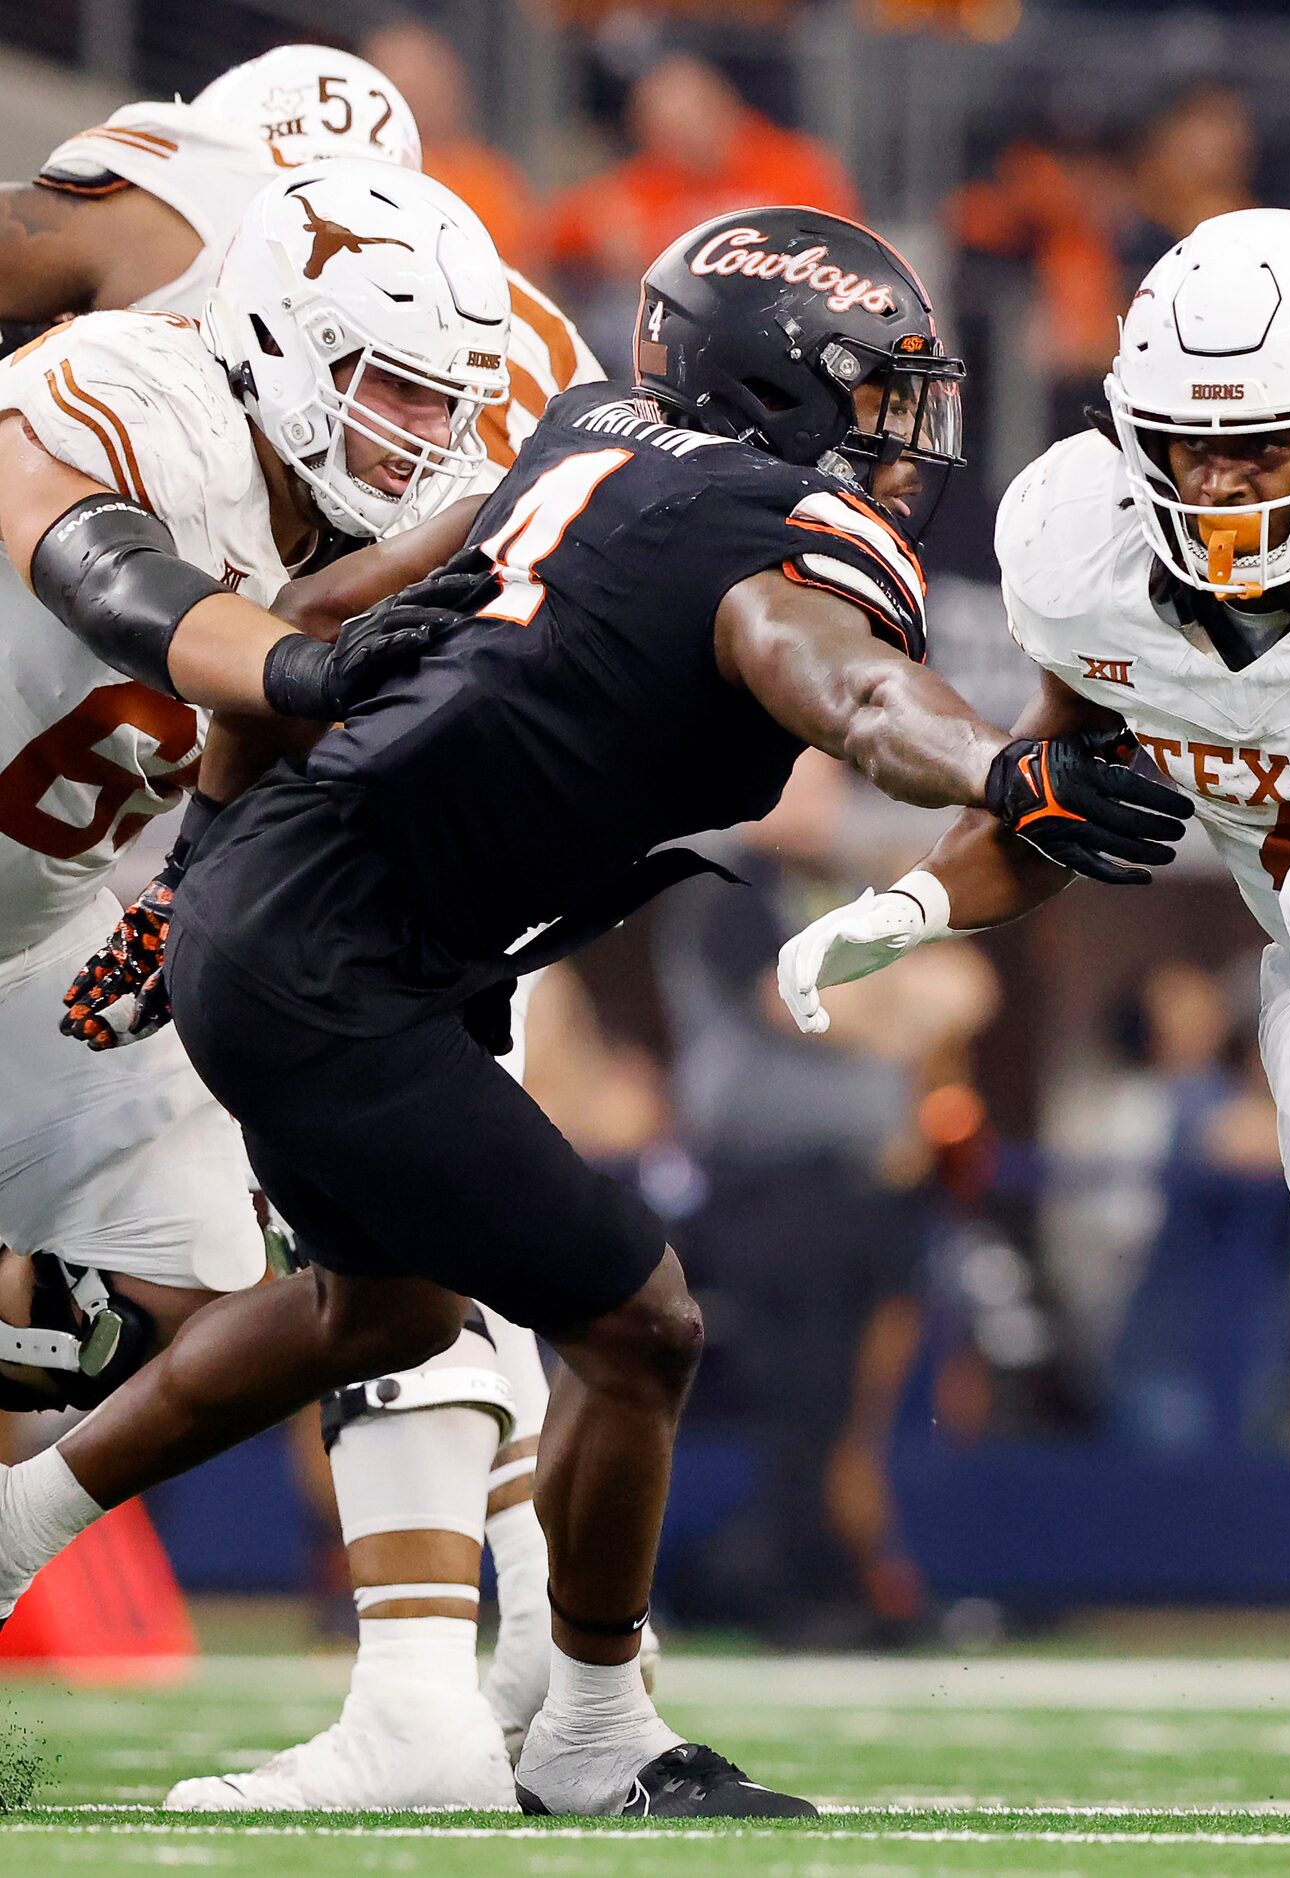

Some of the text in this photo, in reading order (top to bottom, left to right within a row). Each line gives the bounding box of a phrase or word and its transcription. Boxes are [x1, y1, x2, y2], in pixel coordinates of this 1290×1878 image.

[318, 75, 392, 147] 52
[689, 227, 898, 313] Cowboys
[648, 300, 664, 342] 4
[1191, 384, 1244, 400] HORNS
[475, 447, 635, 627] 4
[1079, 655, 1136, 688] XII
